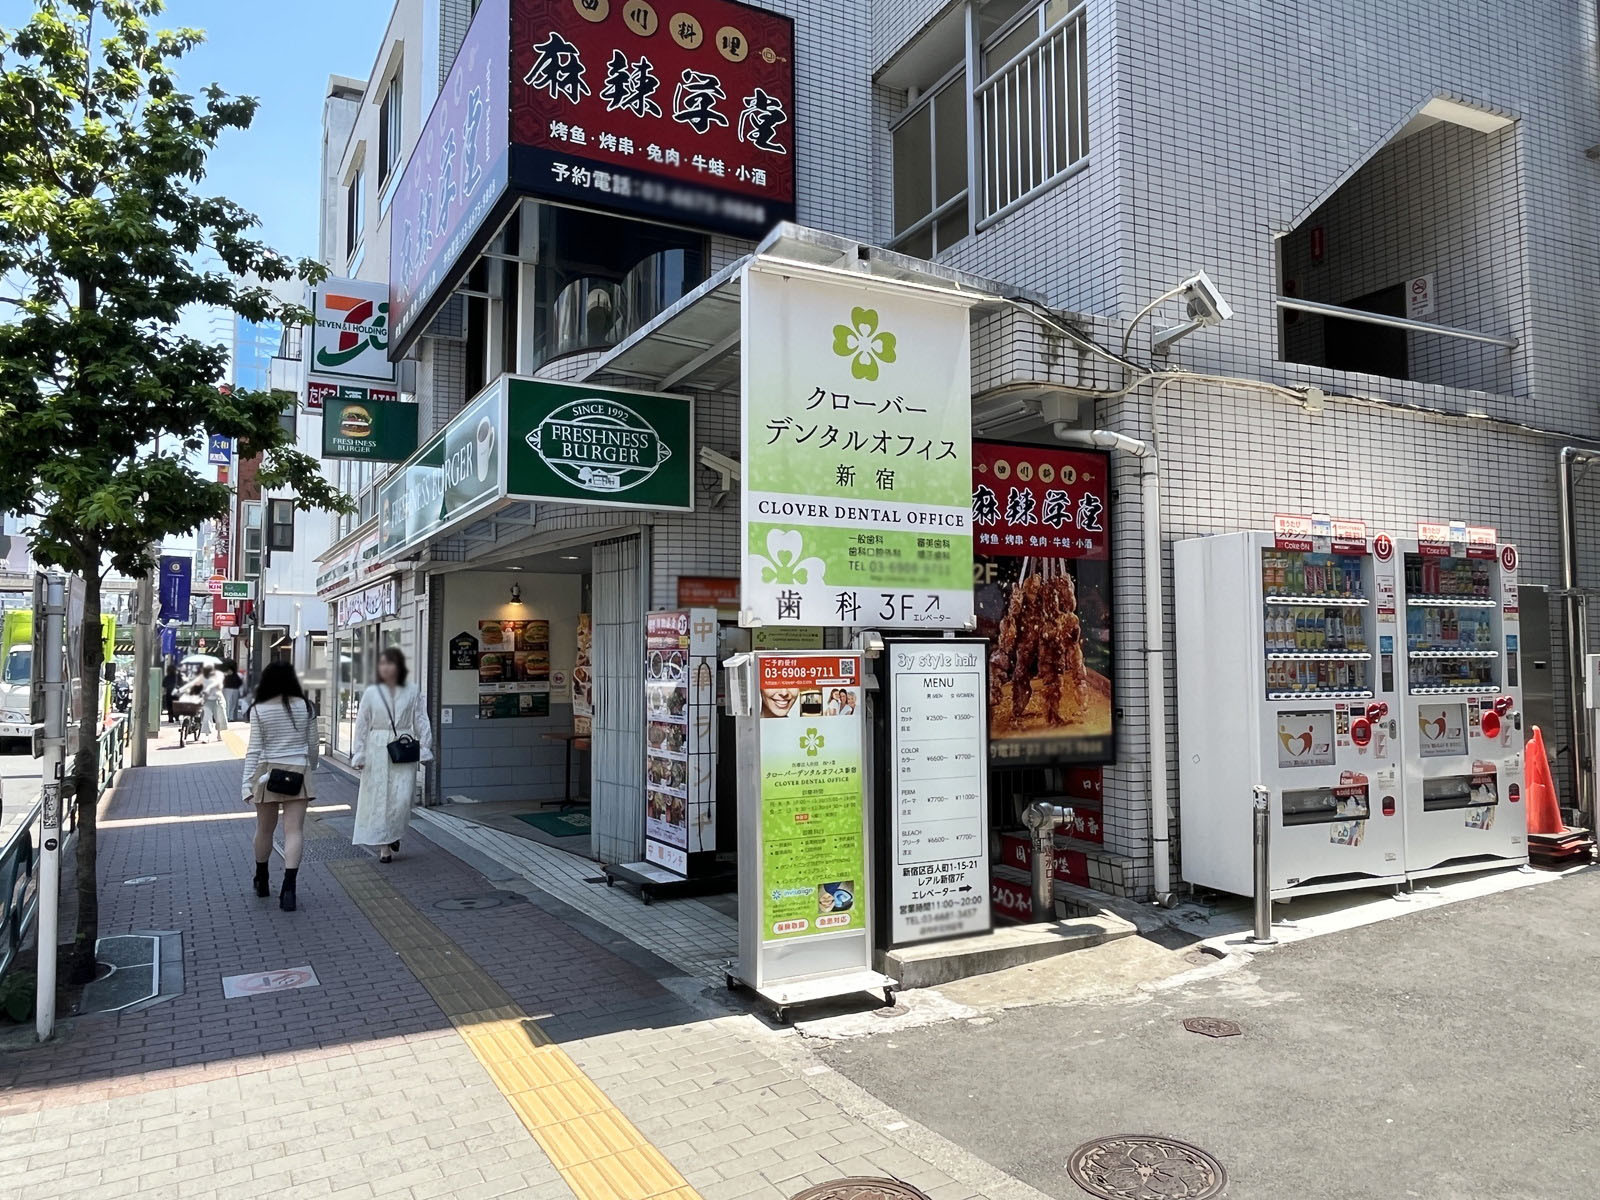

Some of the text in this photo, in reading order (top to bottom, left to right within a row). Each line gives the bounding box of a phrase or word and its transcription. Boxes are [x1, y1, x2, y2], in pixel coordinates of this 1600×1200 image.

[353, 325, 388, 337] HOLDING
[806, 386, 927, 414] クローバー
[572, 405, 629, 422] SINCE 1992
[333, 438, 377, 448] FRESHNESS
[552, 425, 649, 448] FRESHNESS
[766, 417, 957, 461] デンタルオフィス
[337, 445, 371, 455] BURGER
[562, 443, 640, 463] BURGER
[836, 464, 895, 491] 新宿
[758, 501, 965, 527] CLOVER DENTAL OFFICE
[848, 534, 884, 545] 一般歯科
[879, 594, 913, 621] 3F
[914, 614, 951, 622] エレベーター
[919, 653, 952, 670] style
[955, 653, 977, 667] hair
[765, 667, 835, 679] 03-6908-9711
[923, 678, 954, 688] MENU
[912, 888, 957, 900] エレベーター
